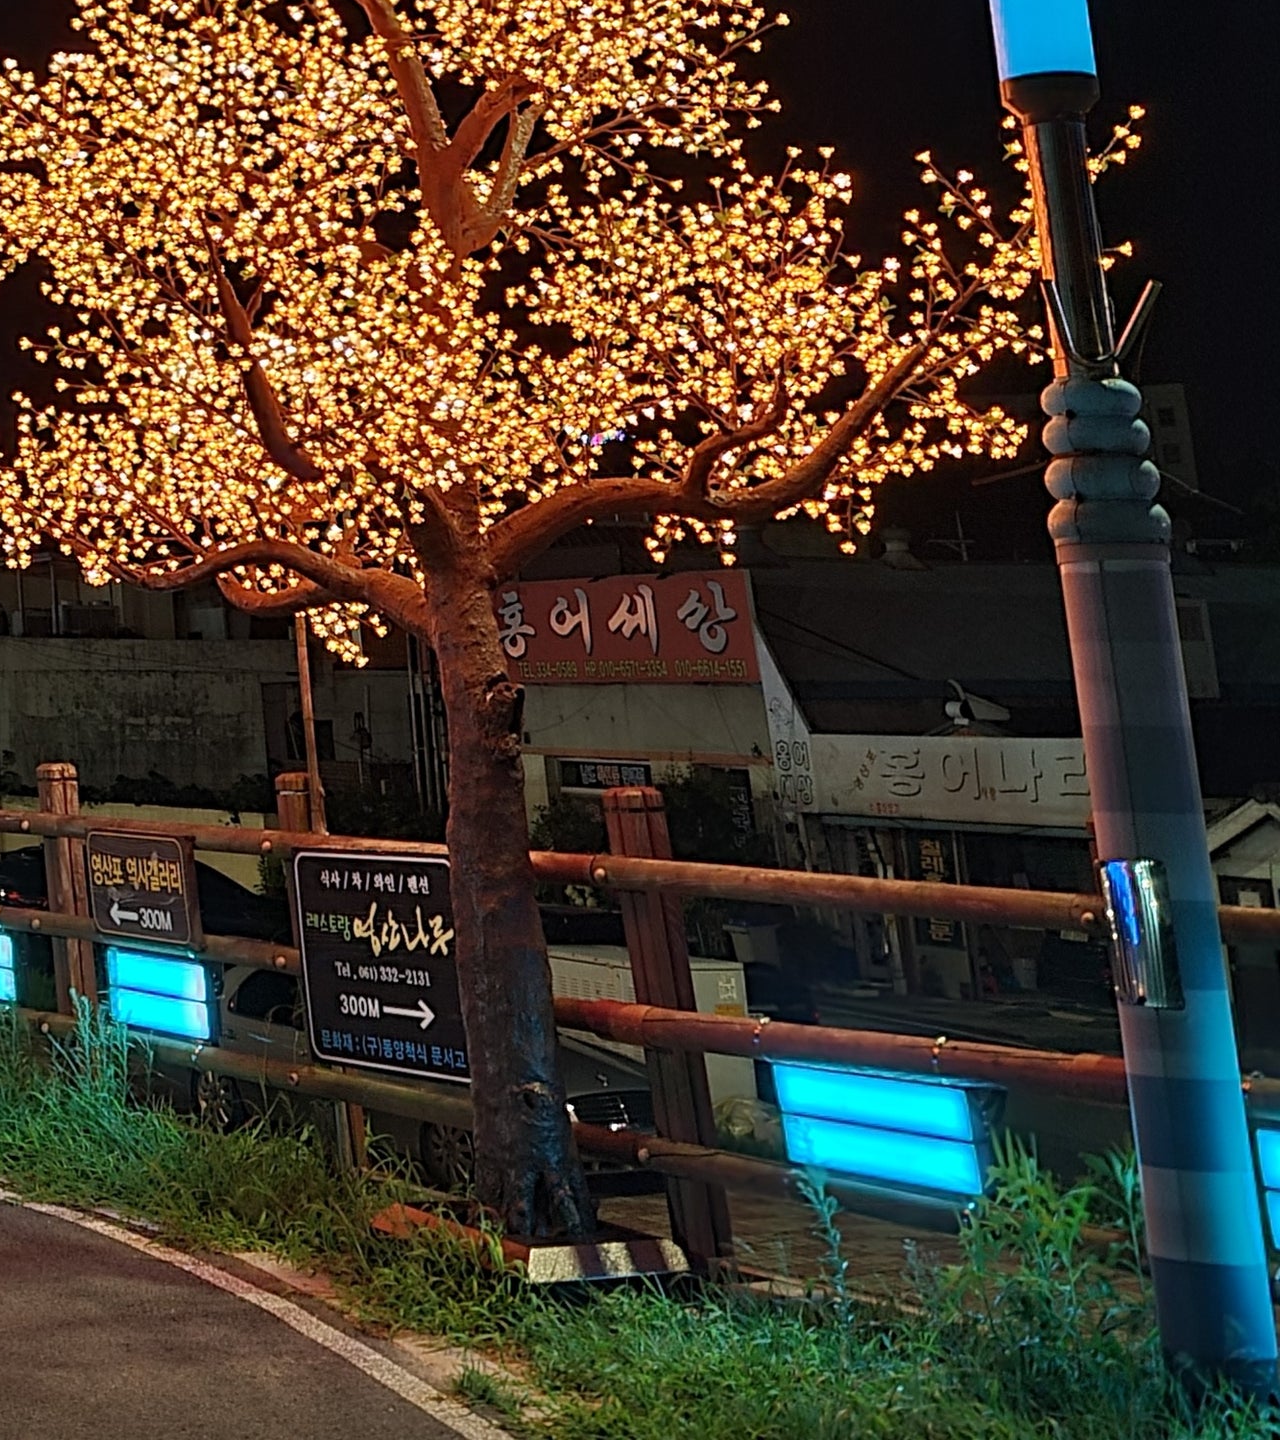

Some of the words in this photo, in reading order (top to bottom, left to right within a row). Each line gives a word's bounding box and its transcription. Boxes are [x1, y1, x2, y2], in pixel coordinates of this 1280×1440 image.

[497, 580, 737, 658] 홍어세상
[91, 854, 124, 886] 영산포
[126, 856, 183, 895] 역사갤러리
[320, 869, 341, 889] 식사
[373, 873, 396, 893] 와인
[139, 907, 173, 932] 300M
[305, 912, 351, 941] 레스토랑
[379, 967, 432, 987] 332-2131
[339, 994, 381, 1019] 300M
[430, 1046, 467, 1069] 문서고
